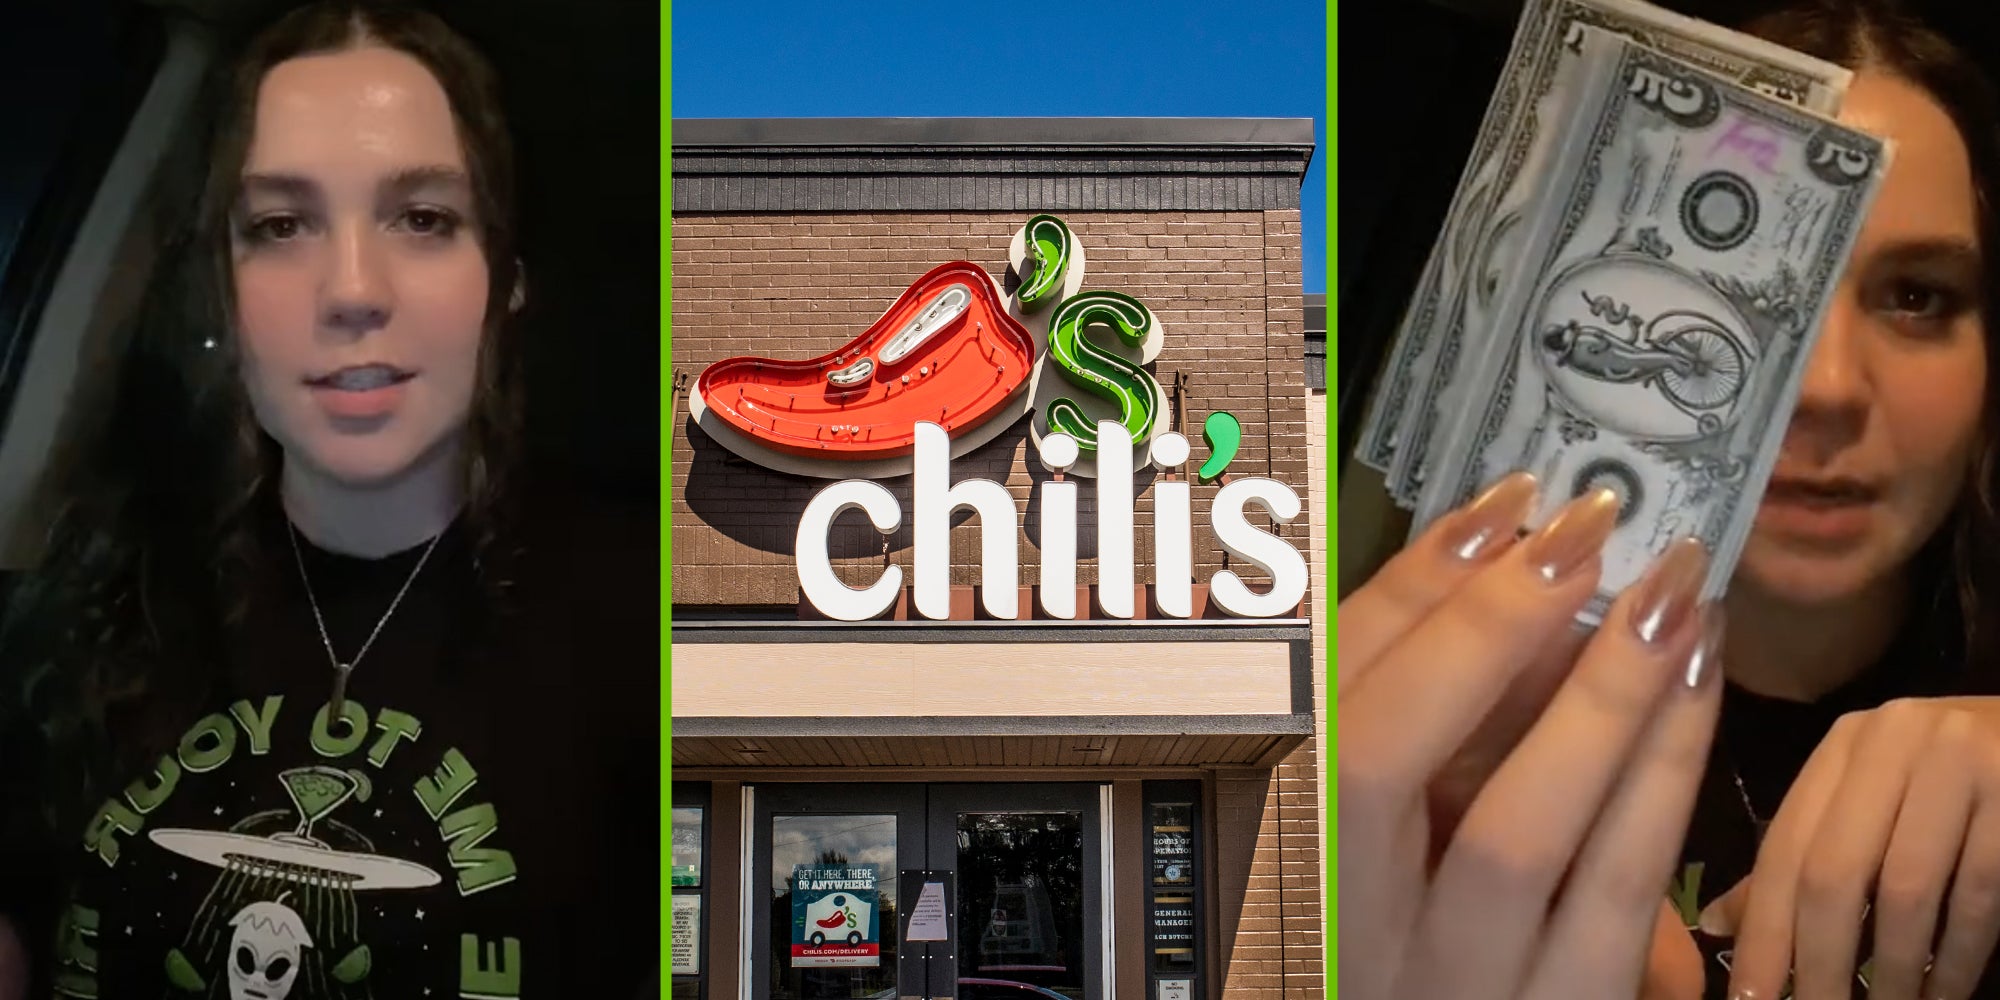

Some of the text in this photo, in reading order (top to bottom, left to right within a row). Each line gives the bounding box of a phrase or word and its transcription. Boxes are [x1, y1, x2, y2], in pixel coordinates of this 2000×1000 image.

[796, 412, 1309, 621] chili's
[798, 869, 812, 880] GET
[813, 869, 821, 880] IT
[798, 880, 810, 890] OR
